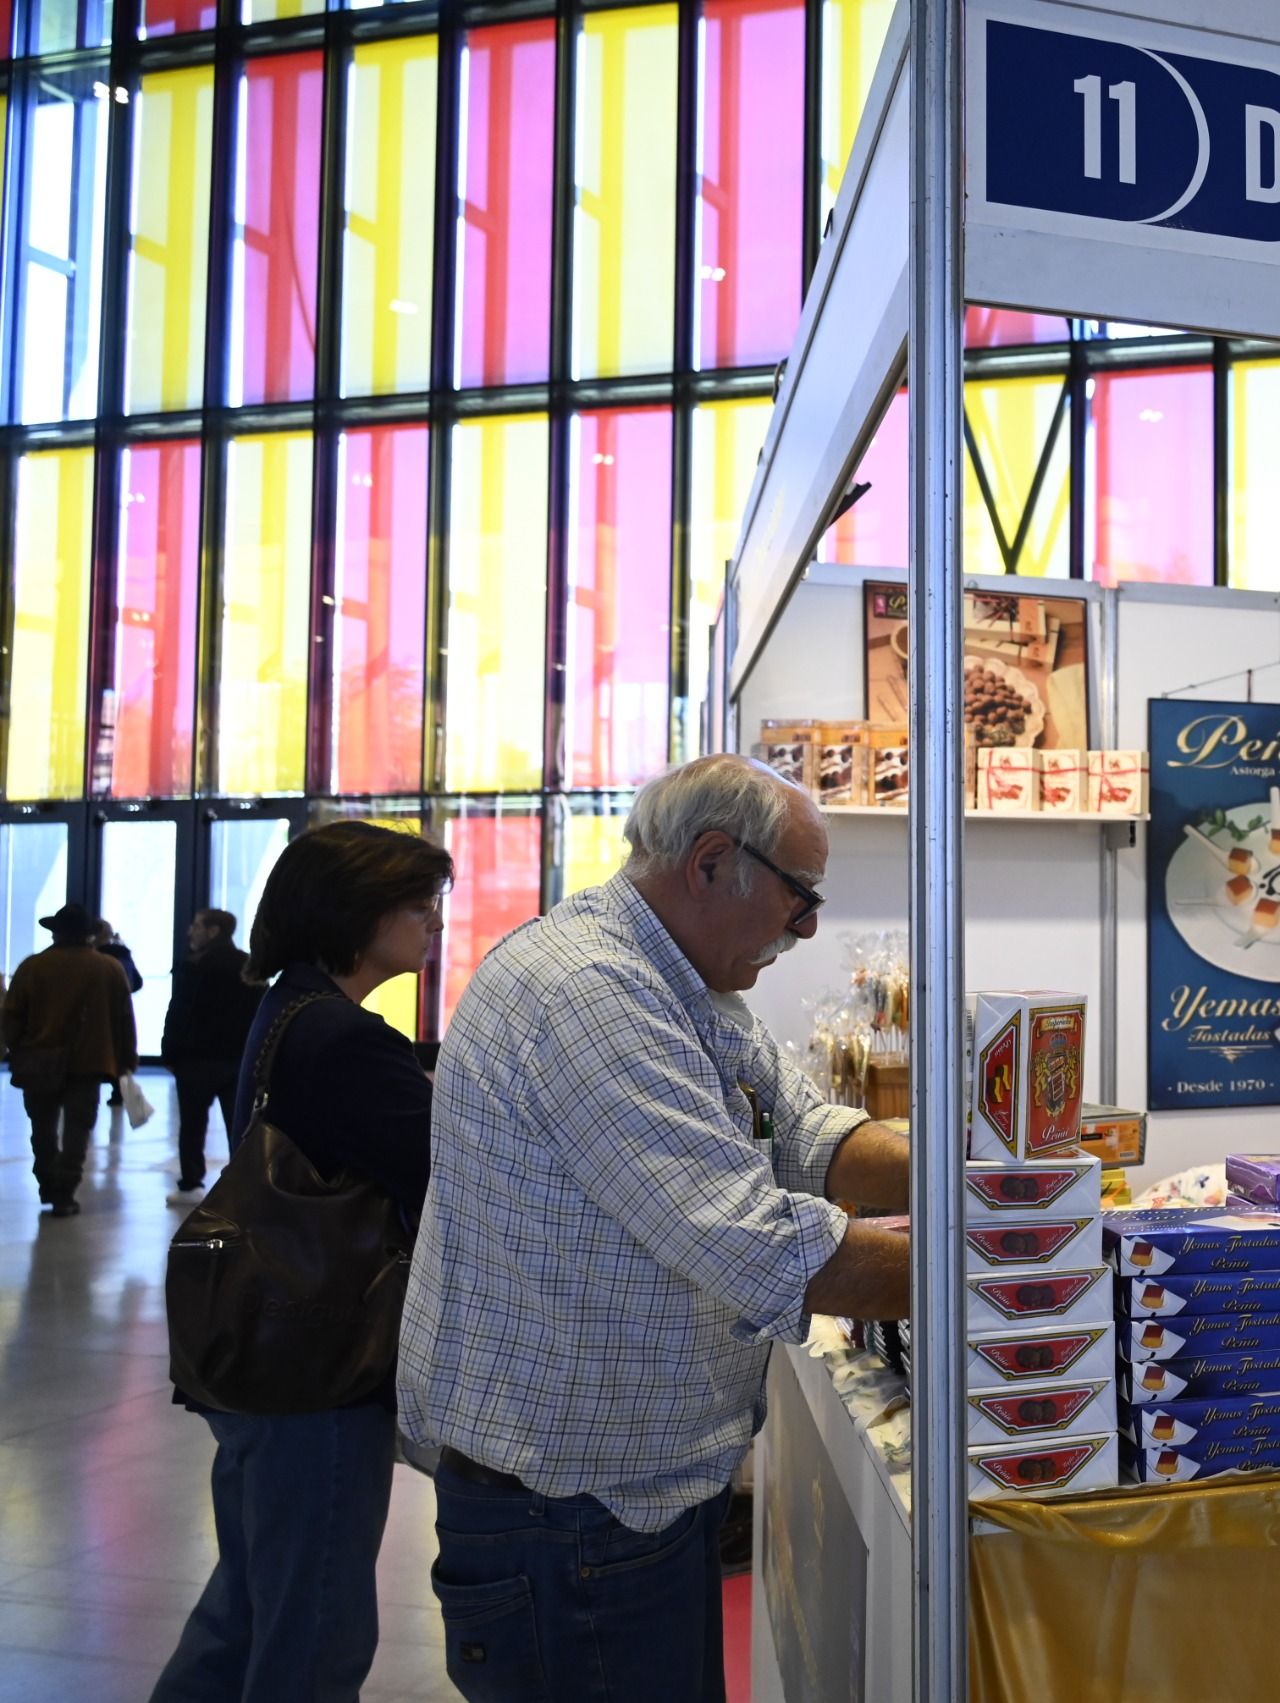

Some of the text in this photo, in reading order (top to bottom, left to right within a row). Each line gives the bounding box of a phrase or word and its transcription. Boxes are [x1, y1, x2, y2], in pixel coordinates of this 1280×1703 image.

[1073, 73, 1137, 185] 11
[1231, 766, 1275, 778] Astorga
[1188, 1025, 1271, 1042] Tostadas
[1177, 1079, 1265, 1093] Desde 1970
[1179, 1235, 1280, 1255] Yemas Tostadas
[1190, 1279, 1232, 1297] Yemas
[1189, 1317, 1230, 1336] Yemas
[1190, 1360, 1232, 1378] Yemas
[1200, 1407, 1243, 1426] Yemas
[1204, 1442, 1245, 1460] Yemas
